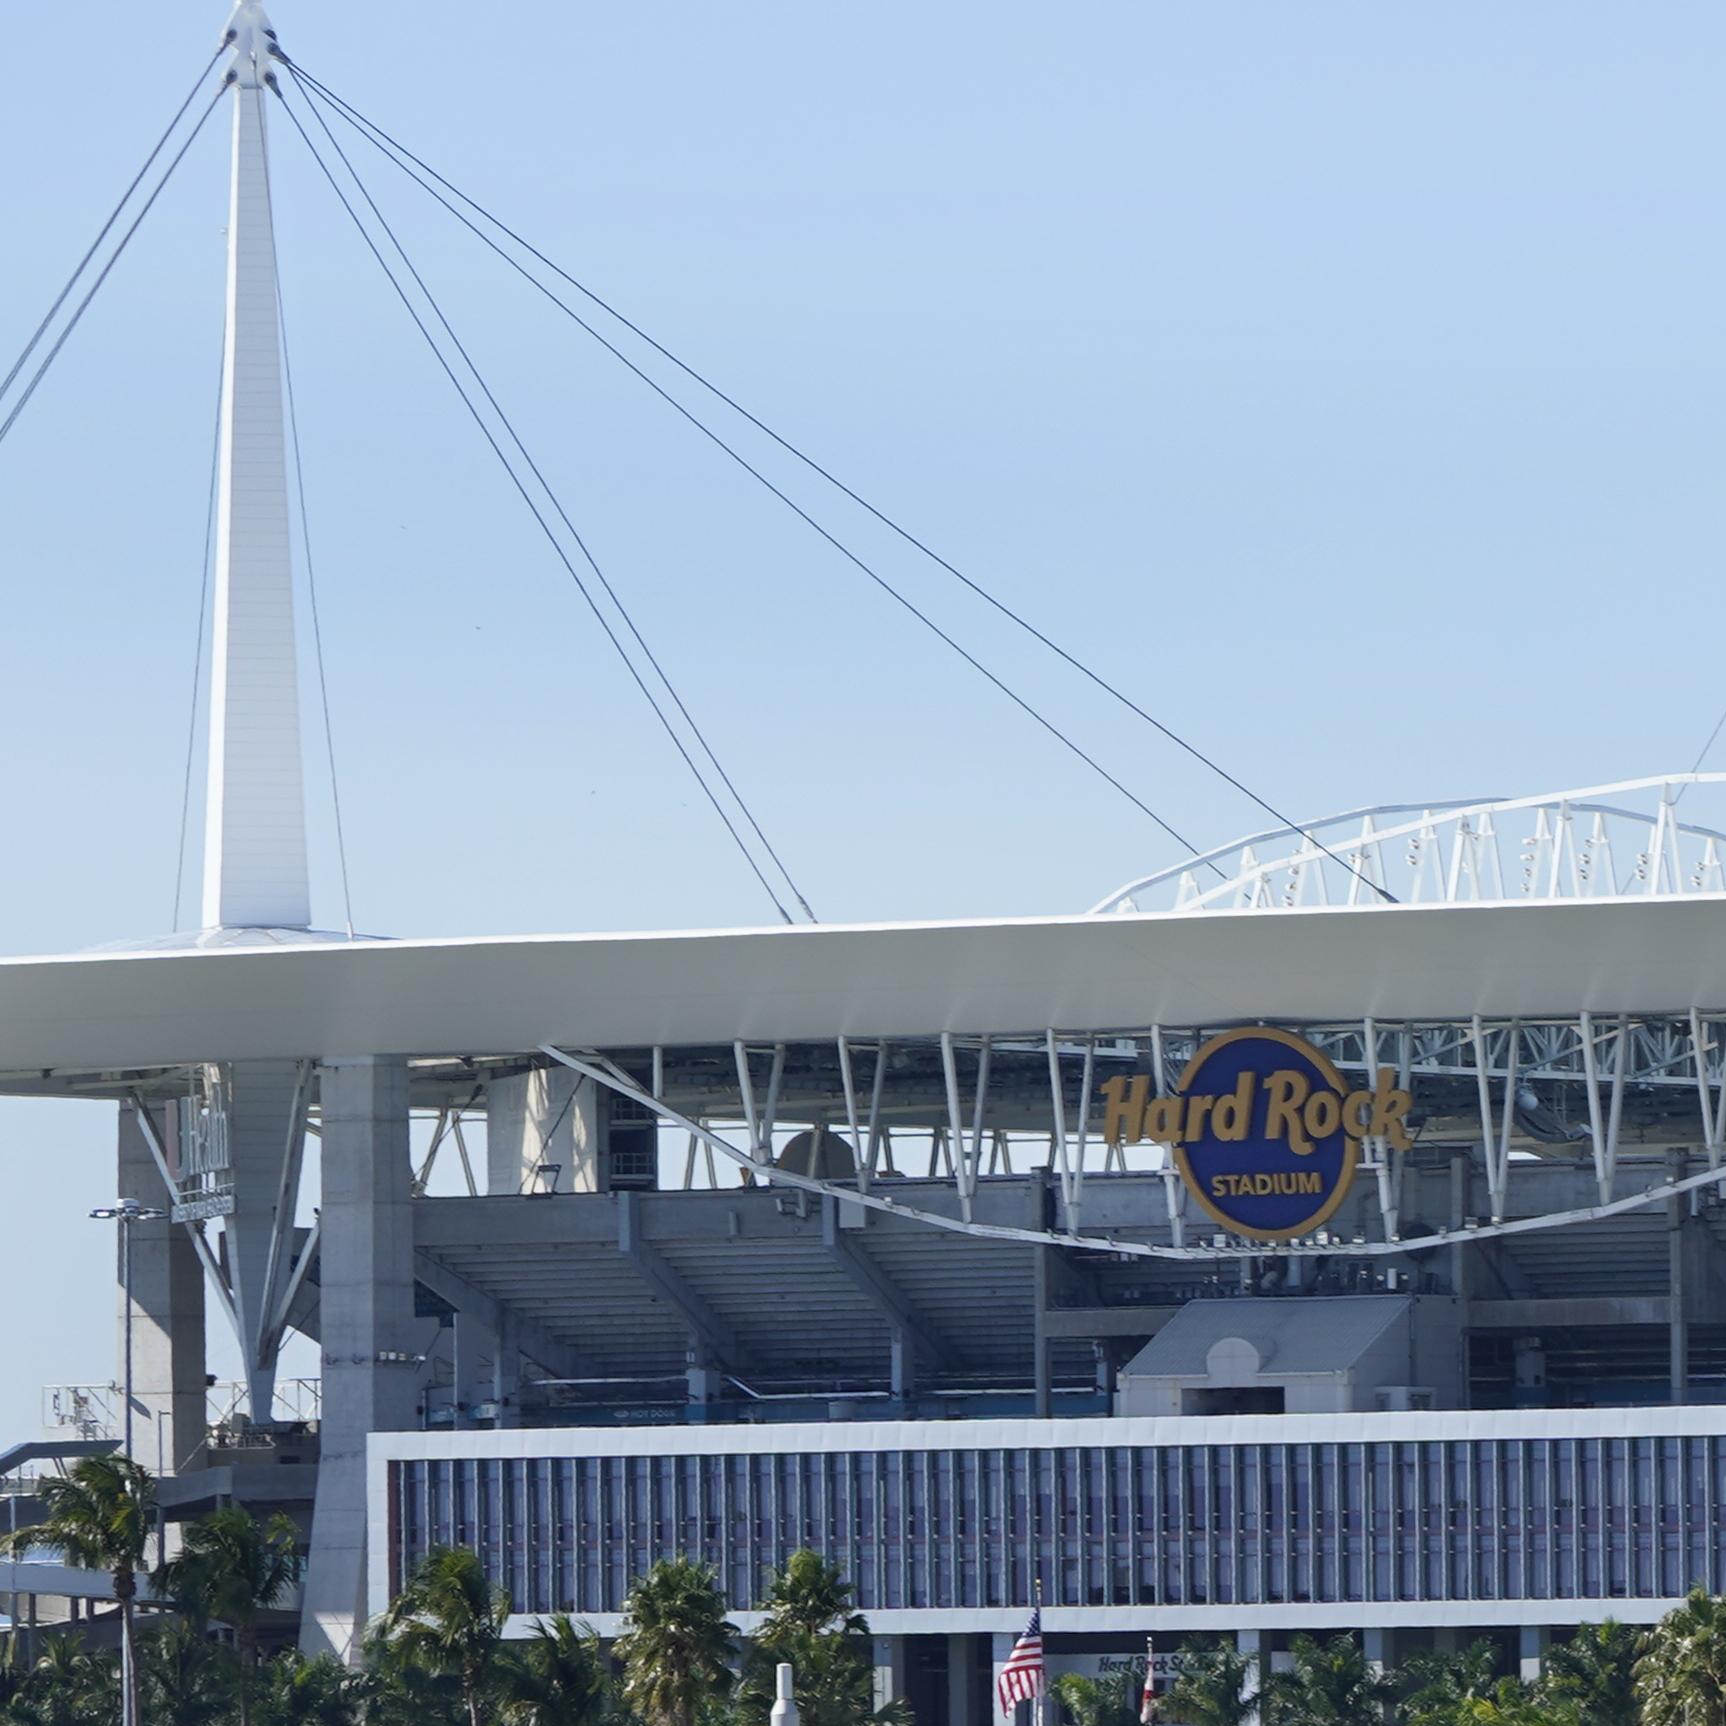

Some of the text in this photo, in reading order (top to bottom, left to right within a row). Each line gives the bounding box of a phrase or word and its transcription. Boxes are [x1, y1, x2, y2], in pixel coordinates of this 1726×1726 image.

[1101, 1067, 1414, 1155] Hard Rock
[1211, 1172, 1322, 1197] STADIUM
[1098, 1655, 1134, 1674] Hard
[1135, 1655, 1169, 1675] Rck
